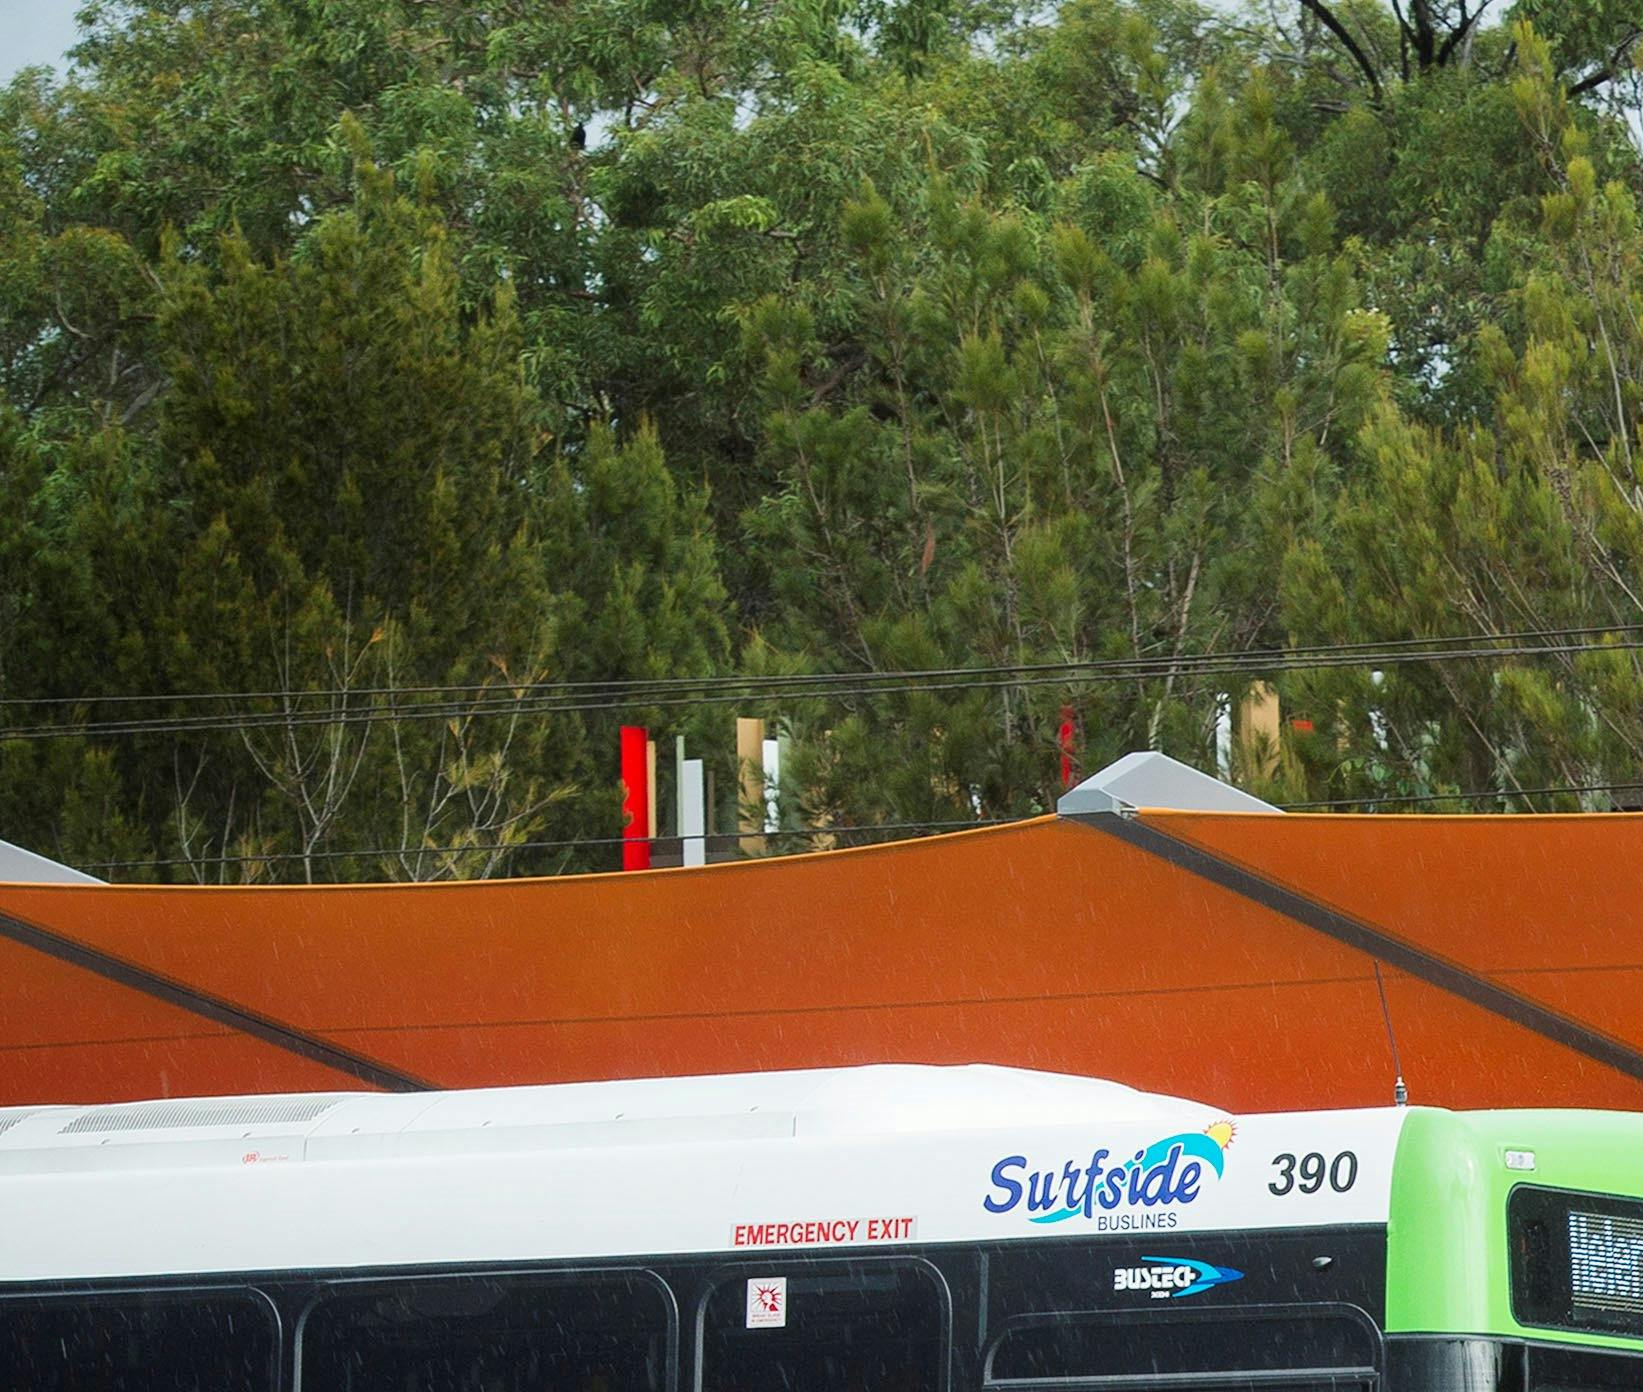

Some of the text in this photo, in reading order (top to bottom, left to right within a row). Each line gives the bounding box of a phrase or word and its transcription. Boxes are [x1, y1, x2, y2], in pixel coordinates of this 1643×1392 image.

[983, 1144, 1201, 1218] Surfside
[1268, 1150, 1359, 1197] 390
[734, 1218, 913, 1246] EMERGENCY EXIT
[1097, 1212, 1178, 1232] BUSLINES
